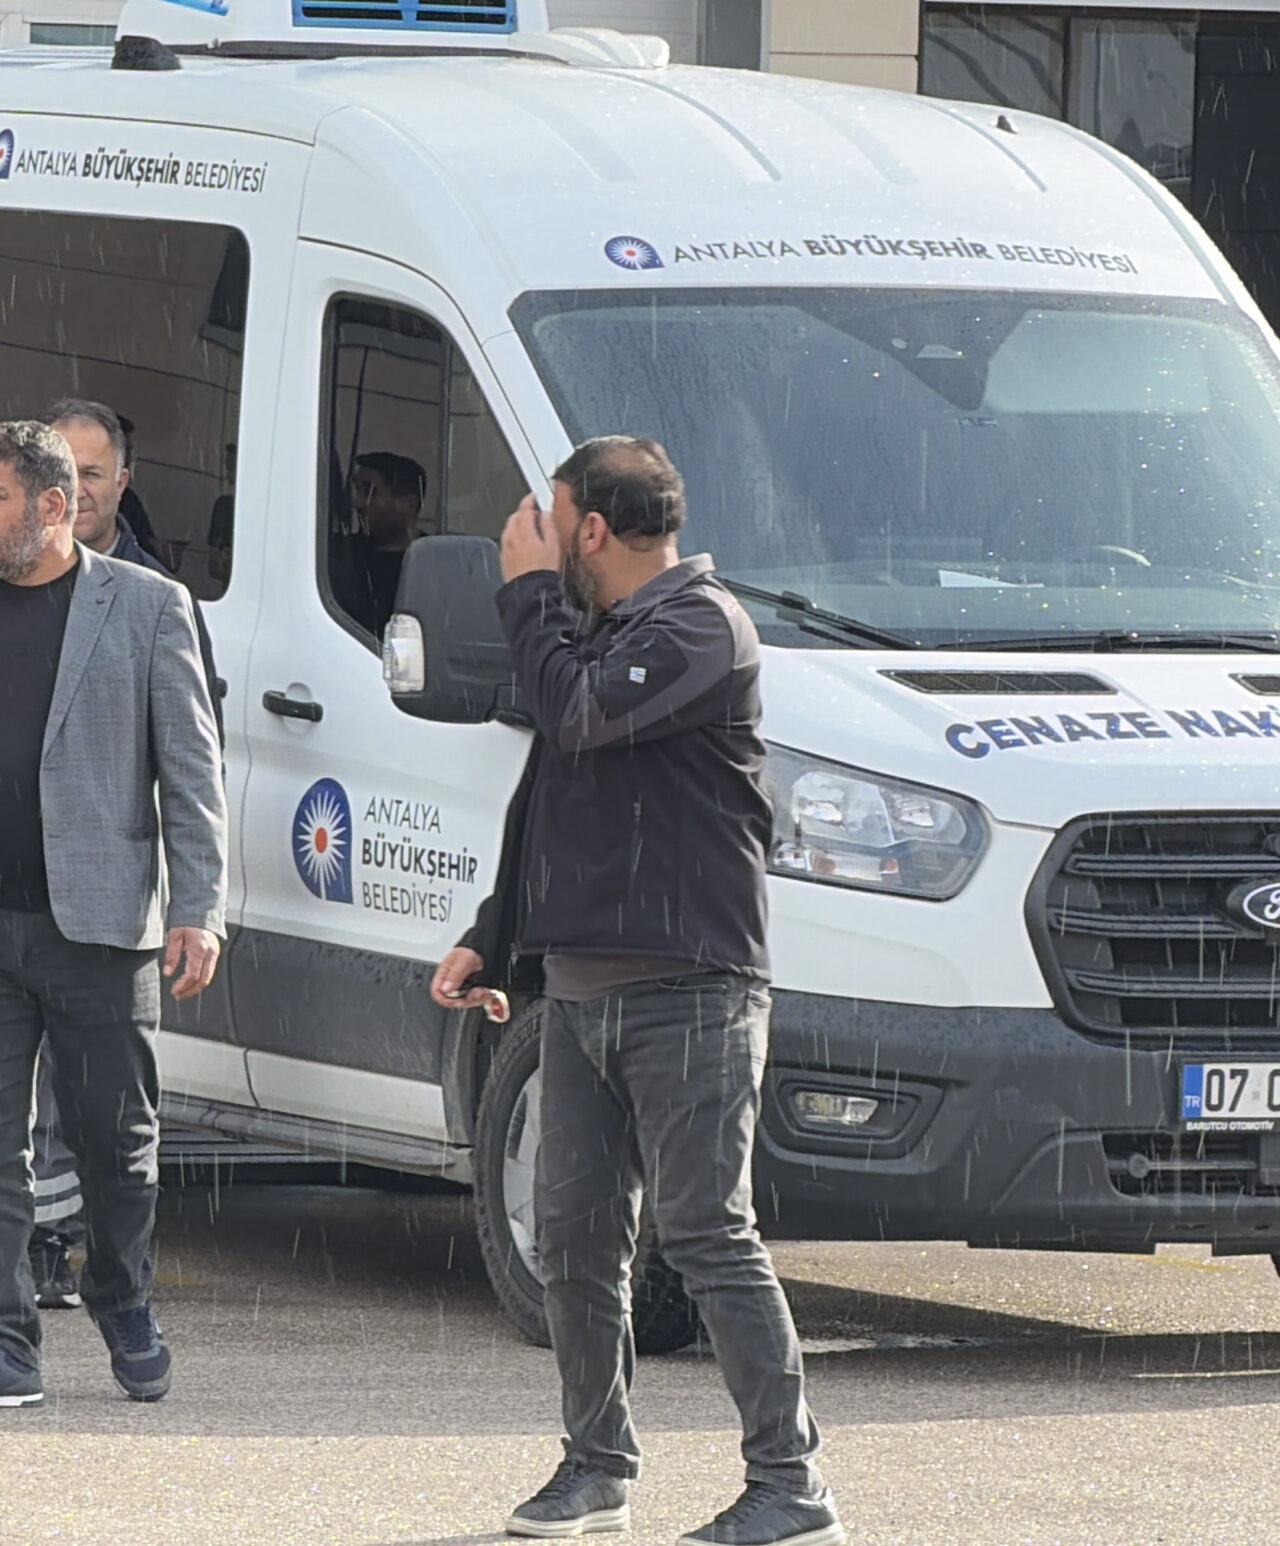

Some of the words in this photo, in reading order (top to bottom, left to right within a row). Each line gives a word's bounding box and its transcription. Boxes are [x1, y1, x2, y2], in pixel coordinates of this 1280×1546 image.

[15, 148, 77, 177] ANTALYA
[82, 146, 181, 188] BÜYÜKŞEHİR
[184, 158, 268, 193] BELEDİYESİ
[674, 239, 802, 263] ANTALYA
[802, 234, 995, 261] BÜYÜKŞEHİR
[996, 244, 1138, 275] BELEDİYESİ
[945, 711, 1172, 759] CENAZE
[363, 795, 441, 834] ANTALYA
[362, 831, 478, 885] BÜYÜKŞEHİR
[362, 881, 453, 924] BELEDİYESİ
[1184, 1095, 1201, 1108] TR
[1205, 1068, 1249, 1112] 07
